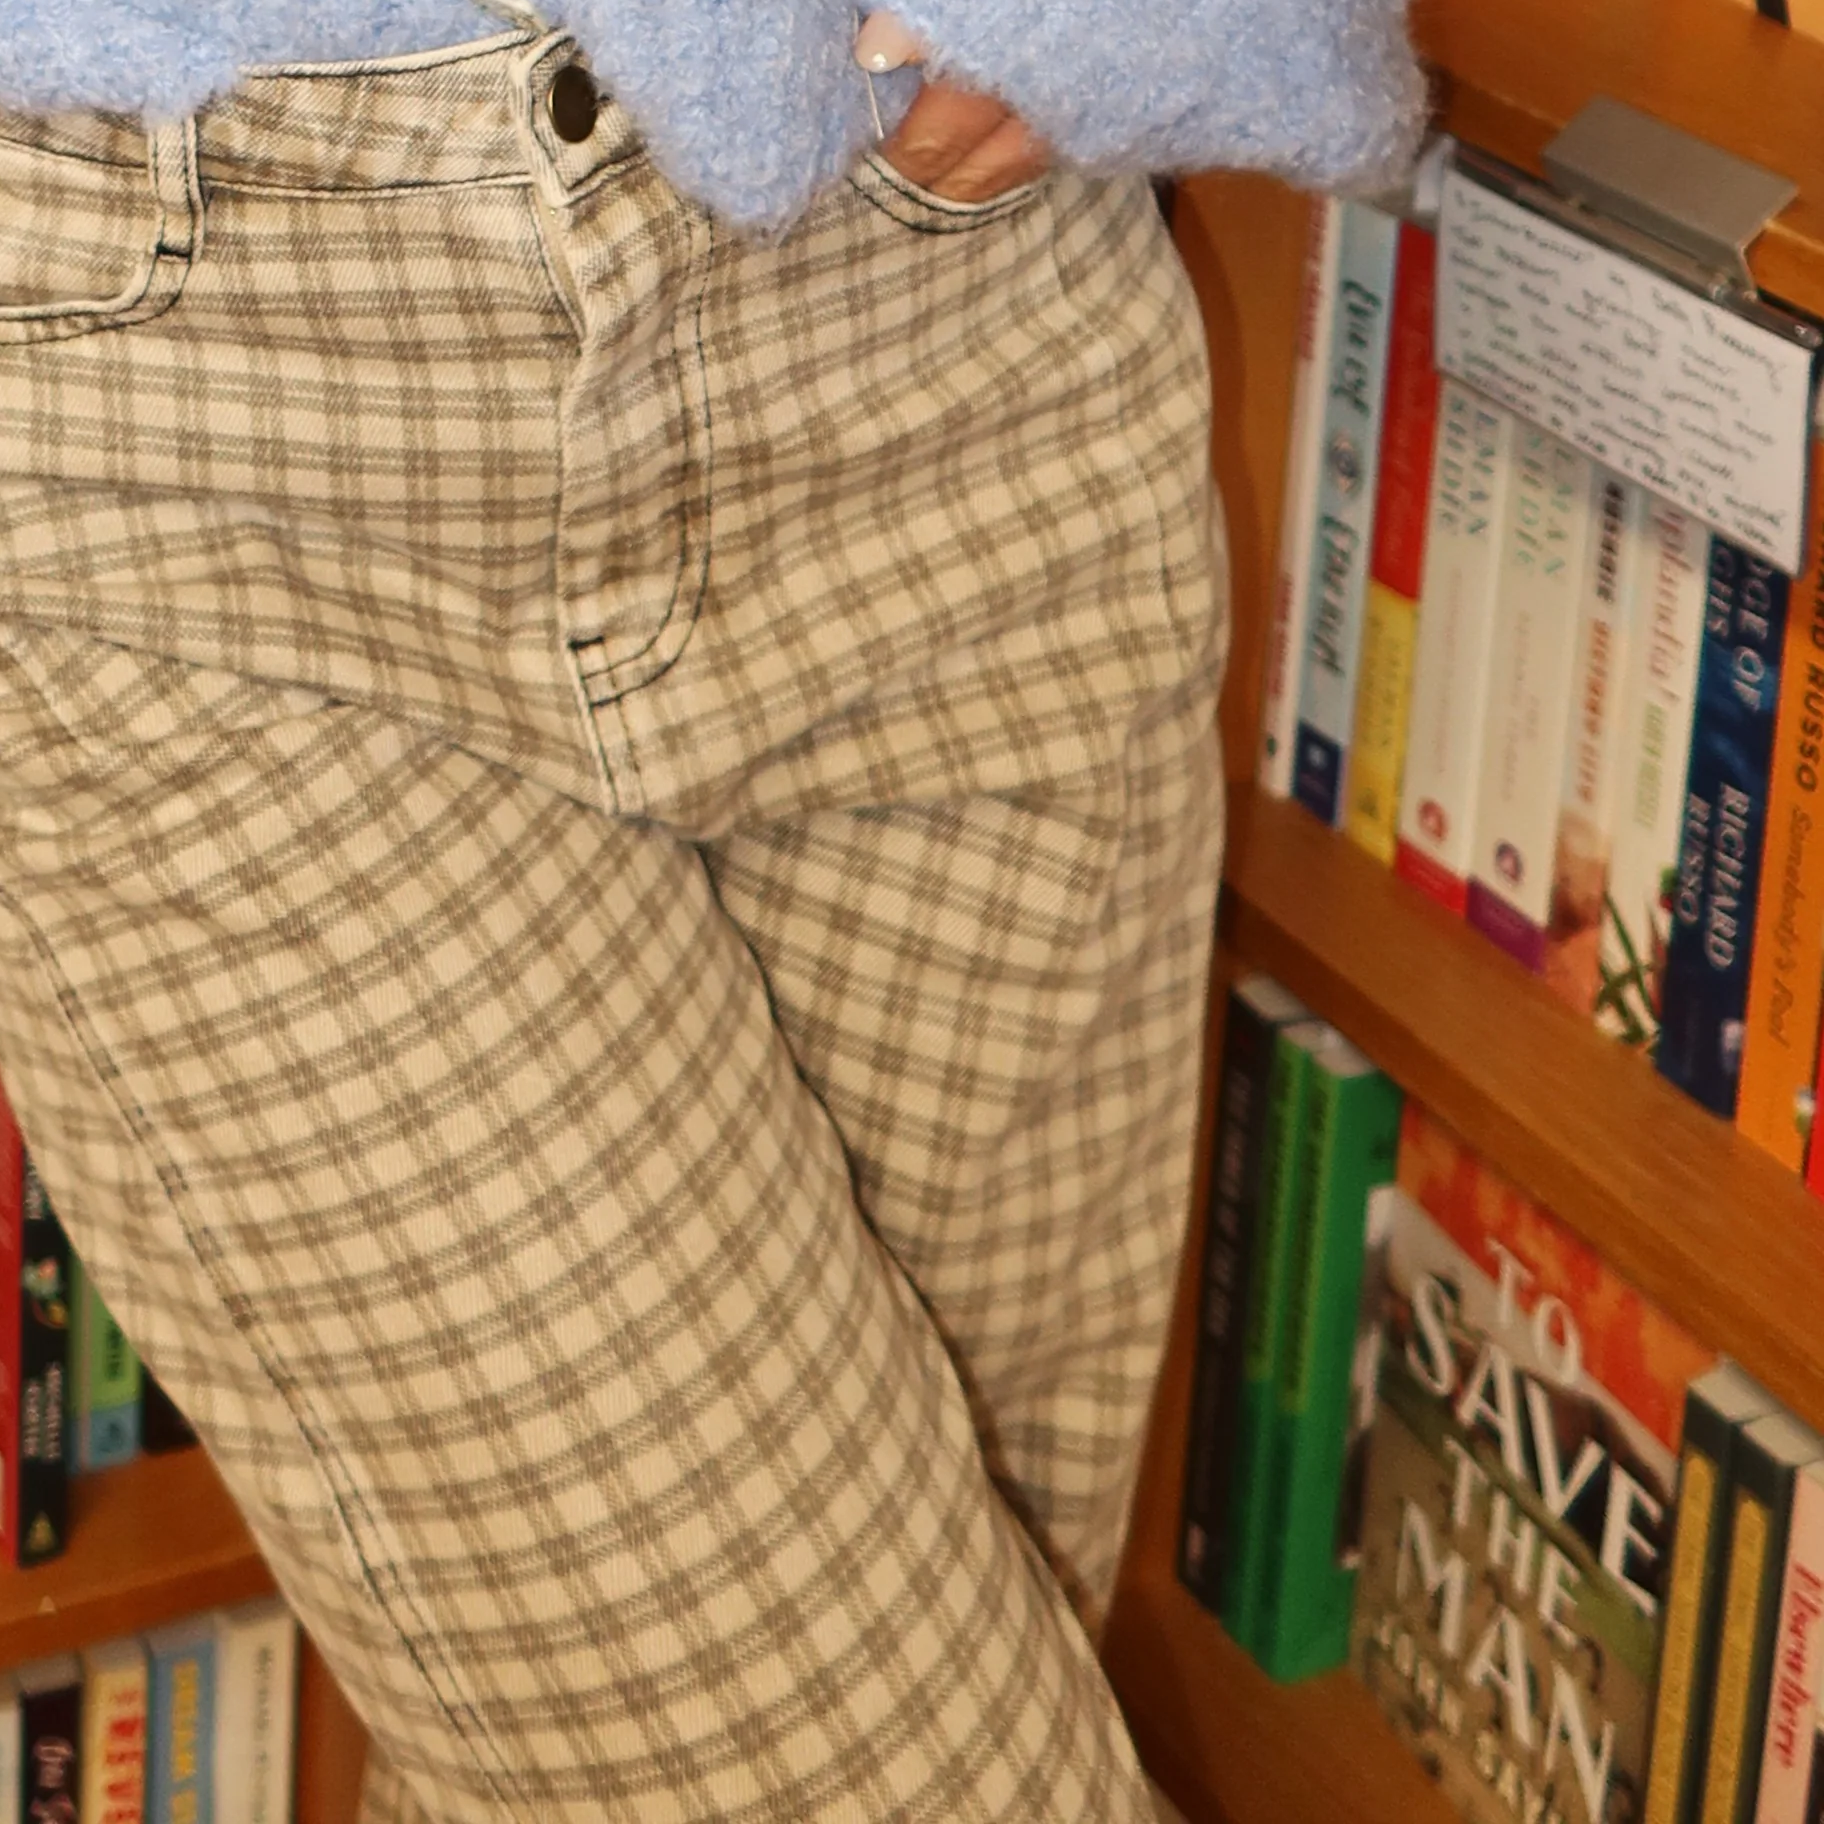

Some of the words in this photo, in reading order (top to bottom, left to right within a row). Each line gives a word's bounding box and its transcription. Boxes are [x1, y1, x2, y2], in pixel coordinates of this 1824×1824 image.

[1676, 793, 1712, 925] RUSSO
[1709, 783, 1750, 971] RICHARD
[1484, 1235, 1582, 1386] TO
[1404, 1273, 1669, 1618] SAVE
[1443, 1435, 1580, 1650] THE
[1394, 1500, 1617, 1824] MAN
